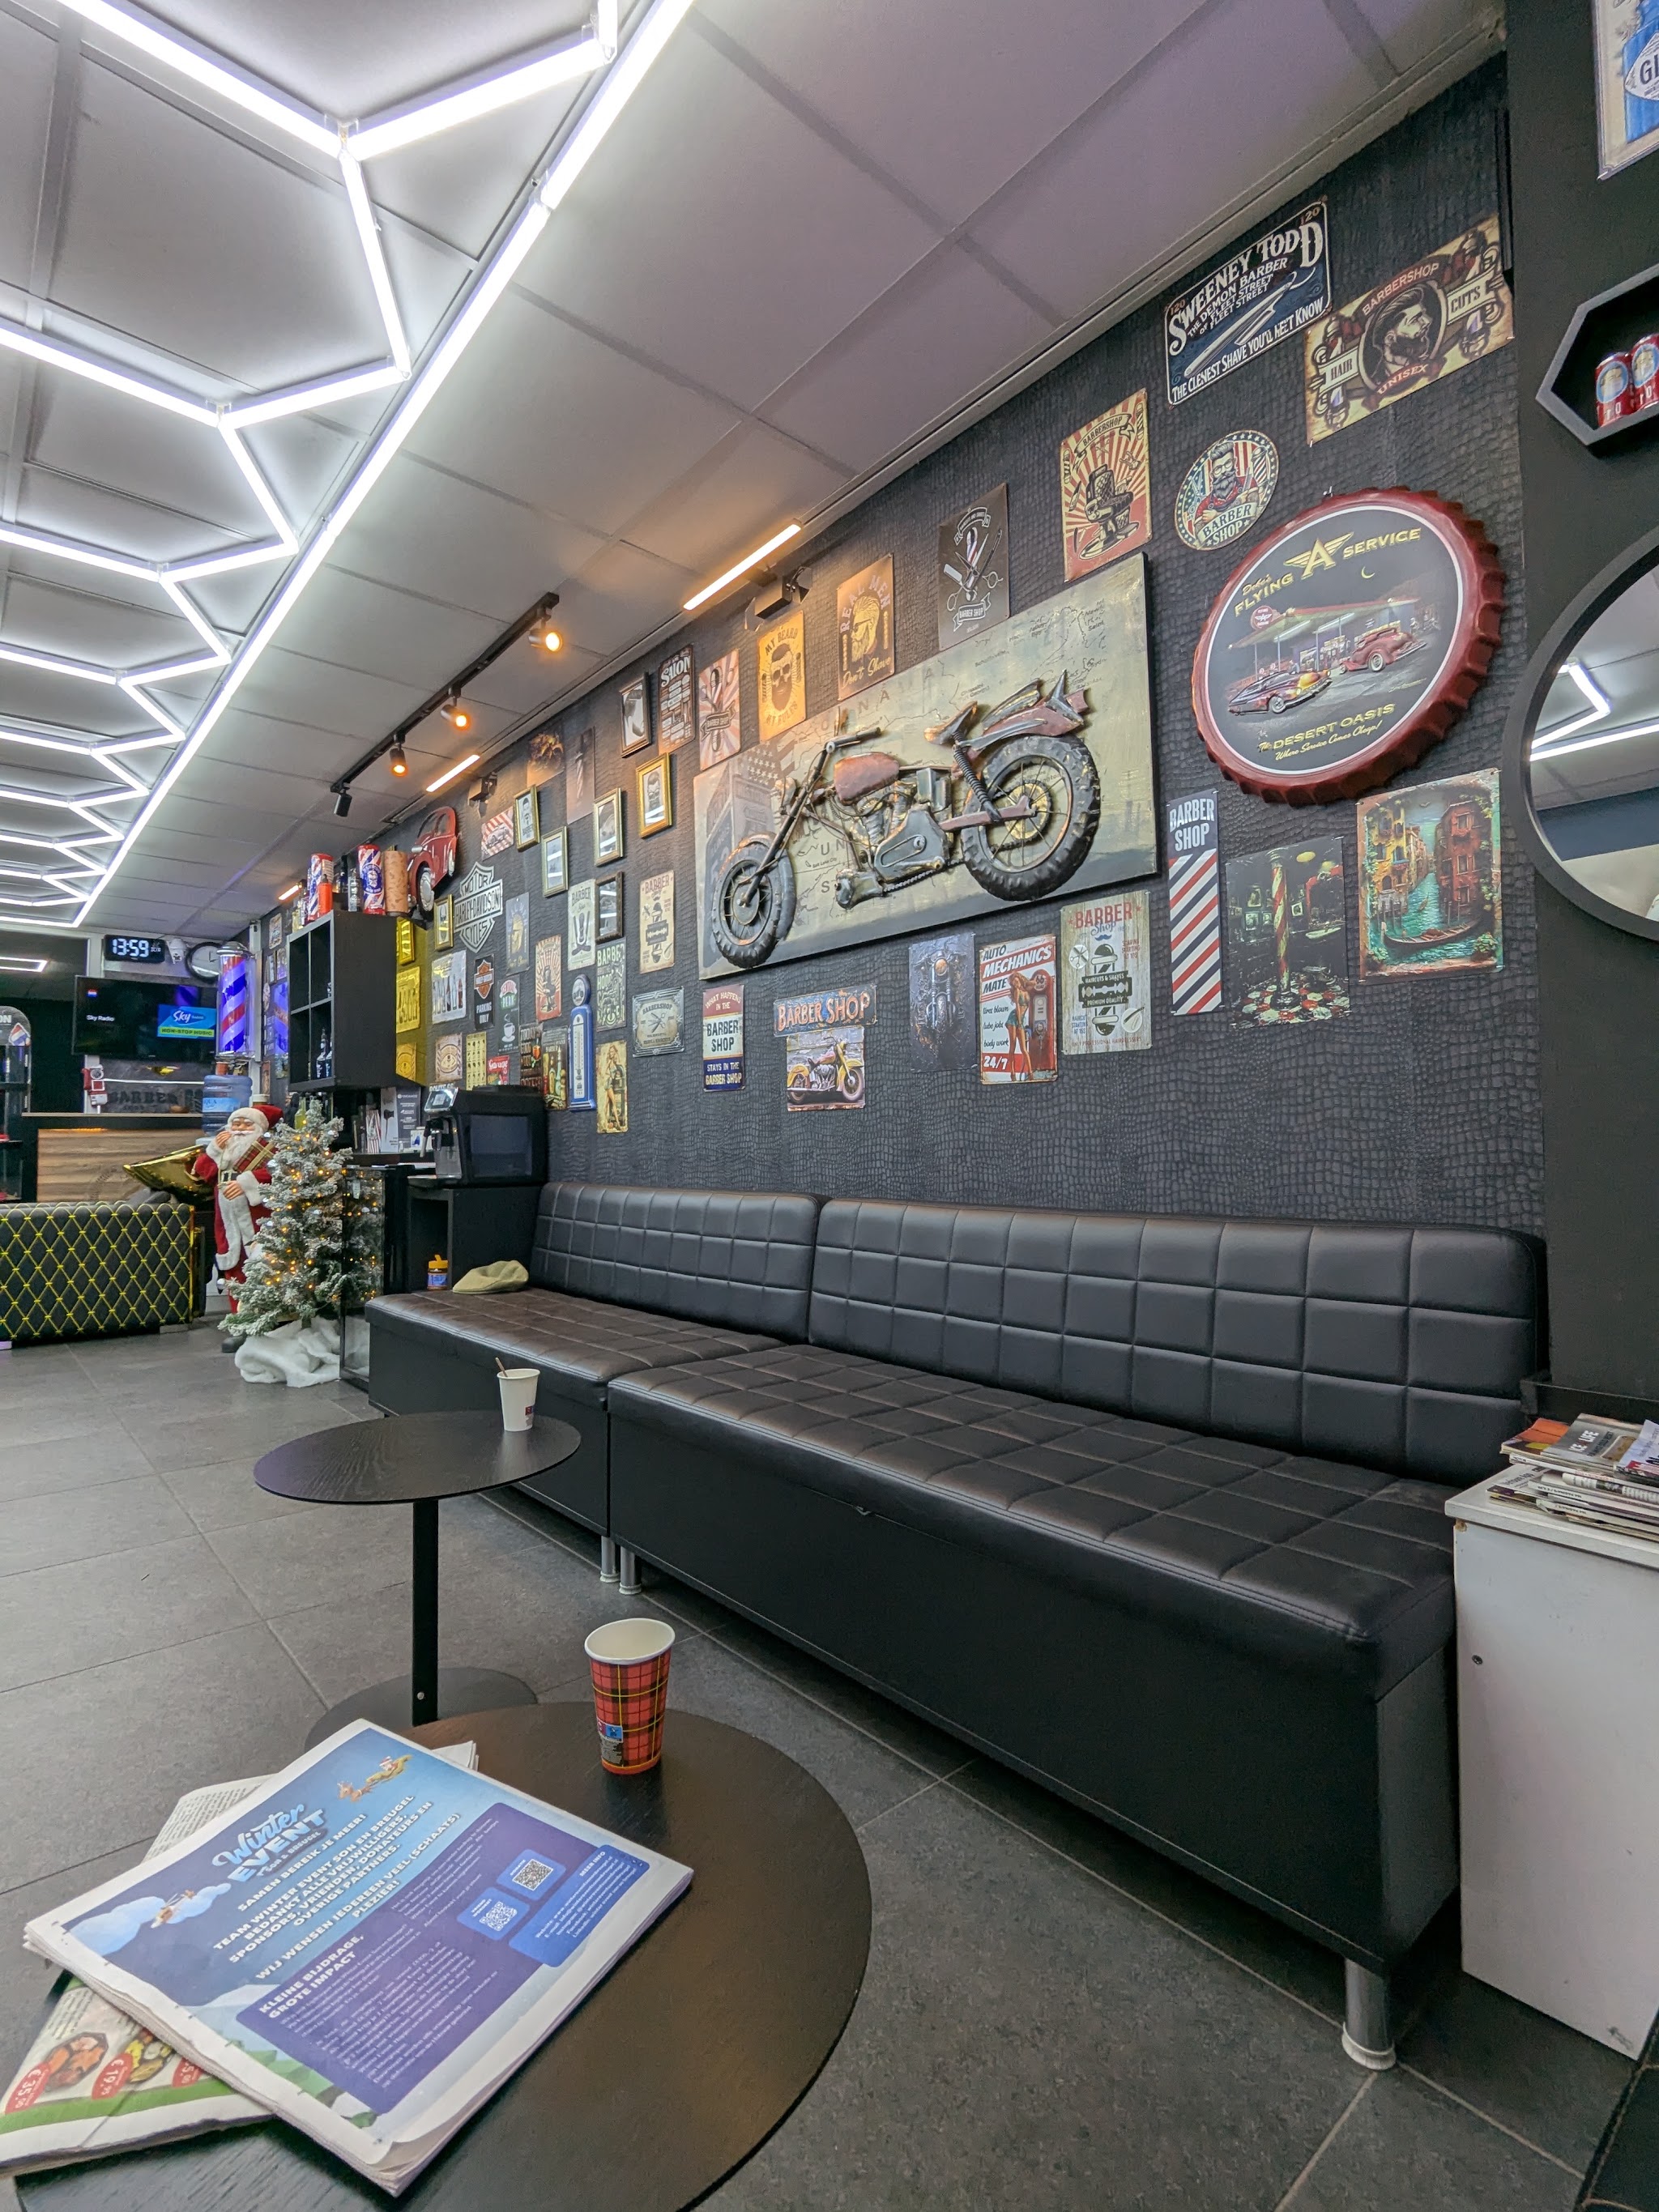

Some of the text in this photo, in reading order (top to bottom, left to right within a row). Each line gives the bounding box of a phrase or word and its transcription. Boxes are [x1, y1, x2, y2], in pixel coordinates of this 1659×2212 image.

[1169, 222, 1323, 356] SWEENEY TODD
[1188, 258, 1288, 338] THE DEMON BARBER
[1235, 283, 1269, 309] STREET
[1362, 262, 1439, 317] BARBERSHOP
[1450, 283, 1482, 314] CUTS
[1171, 383, 1188, 403] THE
[1222, 343, 1247, 372] SHAVE
[1295, 296, 1324, 327] KNOW
[1330, 356, 1354, 381] HAIR
[1378, 363, 1428, 396] UNISEX
[1082, 416, 1123, 445] BARBERSHOP
[1202, 504, 1252, 539] BARBER
[1213, 520, 1243, 546] SHOP
[1235, 572, 1294, 618] FLYING
[1342, 527, 1422, 560] SERVICE
[959, 607, 983, 618] BARBER SHOP
[765, 627, 798, 656] MY BEARD
[660, 655, 690, 688] SALON
[1273, 722, 1337, 751] DESERT
[1341, 703, 1396, 729] OASIS
[1274, 748, 1300, 761] Where
[1300, 739, 1328, 754] Service
[1328, 732, 1352, 745] Comes
[1168, 798, 1215, 833] BARBER
[1175, 823, 1210, 852] SHOP
[464, 874, 488, 894] MOTOR
[571, 887, 591, 907] BARBER
[454, 889, 500, 926] HARLEY-DAVIDSON
[1075, 901, 1132, 929] BARBER
[465, 920, 488, 940] CYCLES
[1090, 920, 1116, 936] Shop
[112, 938, 149, 958] 13:59
[982, 945, 1052, 979] MECHANICS
[983, 944, 1007, 961] AUTO
[983, 977, 1008, 995] MATE
[86, 1014, 96, 1022] Sky
[173, 1010, 191, 1024] Sky
[476, 1001, 493, 1014] PARKING
[721, 1001, 731, 1009] THE
[778, 991, 871, 1032] BARBER SHOP
[706, 1020, 739, 1037] BARBER
[711, 1037, 735, 1053] SHOP
[706, 1063, 722, 1072] STAYS
[730, 1061, 740, 1070] THE
[983, 1055, 1008, 1070] 24/7
[727, 1072, 742, 1085] SHOP
[212, 1804, 304, 1866] Winter
[228, 1809, 326, 1882] EVENT
[213, 1795, 415, 1950] TEAM WINTER EVENT SON EN BREUGEL
[237, 1813, 367, 1912] SAMEN BEREIK JE MEER!
[244, 1896, 301, 1941] BEDANKT
[302, 1878, 330, 1899] ALLE
[326, 1813, 408, 1878] VRIJWILLIGERS,
[578, 1851, 606, 1877] MEER INFO
[229, 1911, 301, 1963] SPONSORS,
[298, 1865, 360, 1912] VRIENDEN,
[358, 1813, 420, 1865] DONATEURS
[417, 1801, 433, 1816] EN
[255, 1960, 283, 1980] WIJ
[281, 1920, 334, 1961] WENSEN
[332, 1879, 385, 1922] IEDEREEN
[384, 1858, 411, 1881] VEEL
[407, 1813, 462, 1860] (SCHAATS)
[293, 1887, 344, 1926] OVERIGE
[343, 1843, 401, 1888] PARTNERS.
[352, 1879, 401, 1919] PLEZIER!
[258, 1934, 365, 2014] KLEINE BIJDRAGE,
[268, 1950, 356, 2019] GROTE IMPACT
